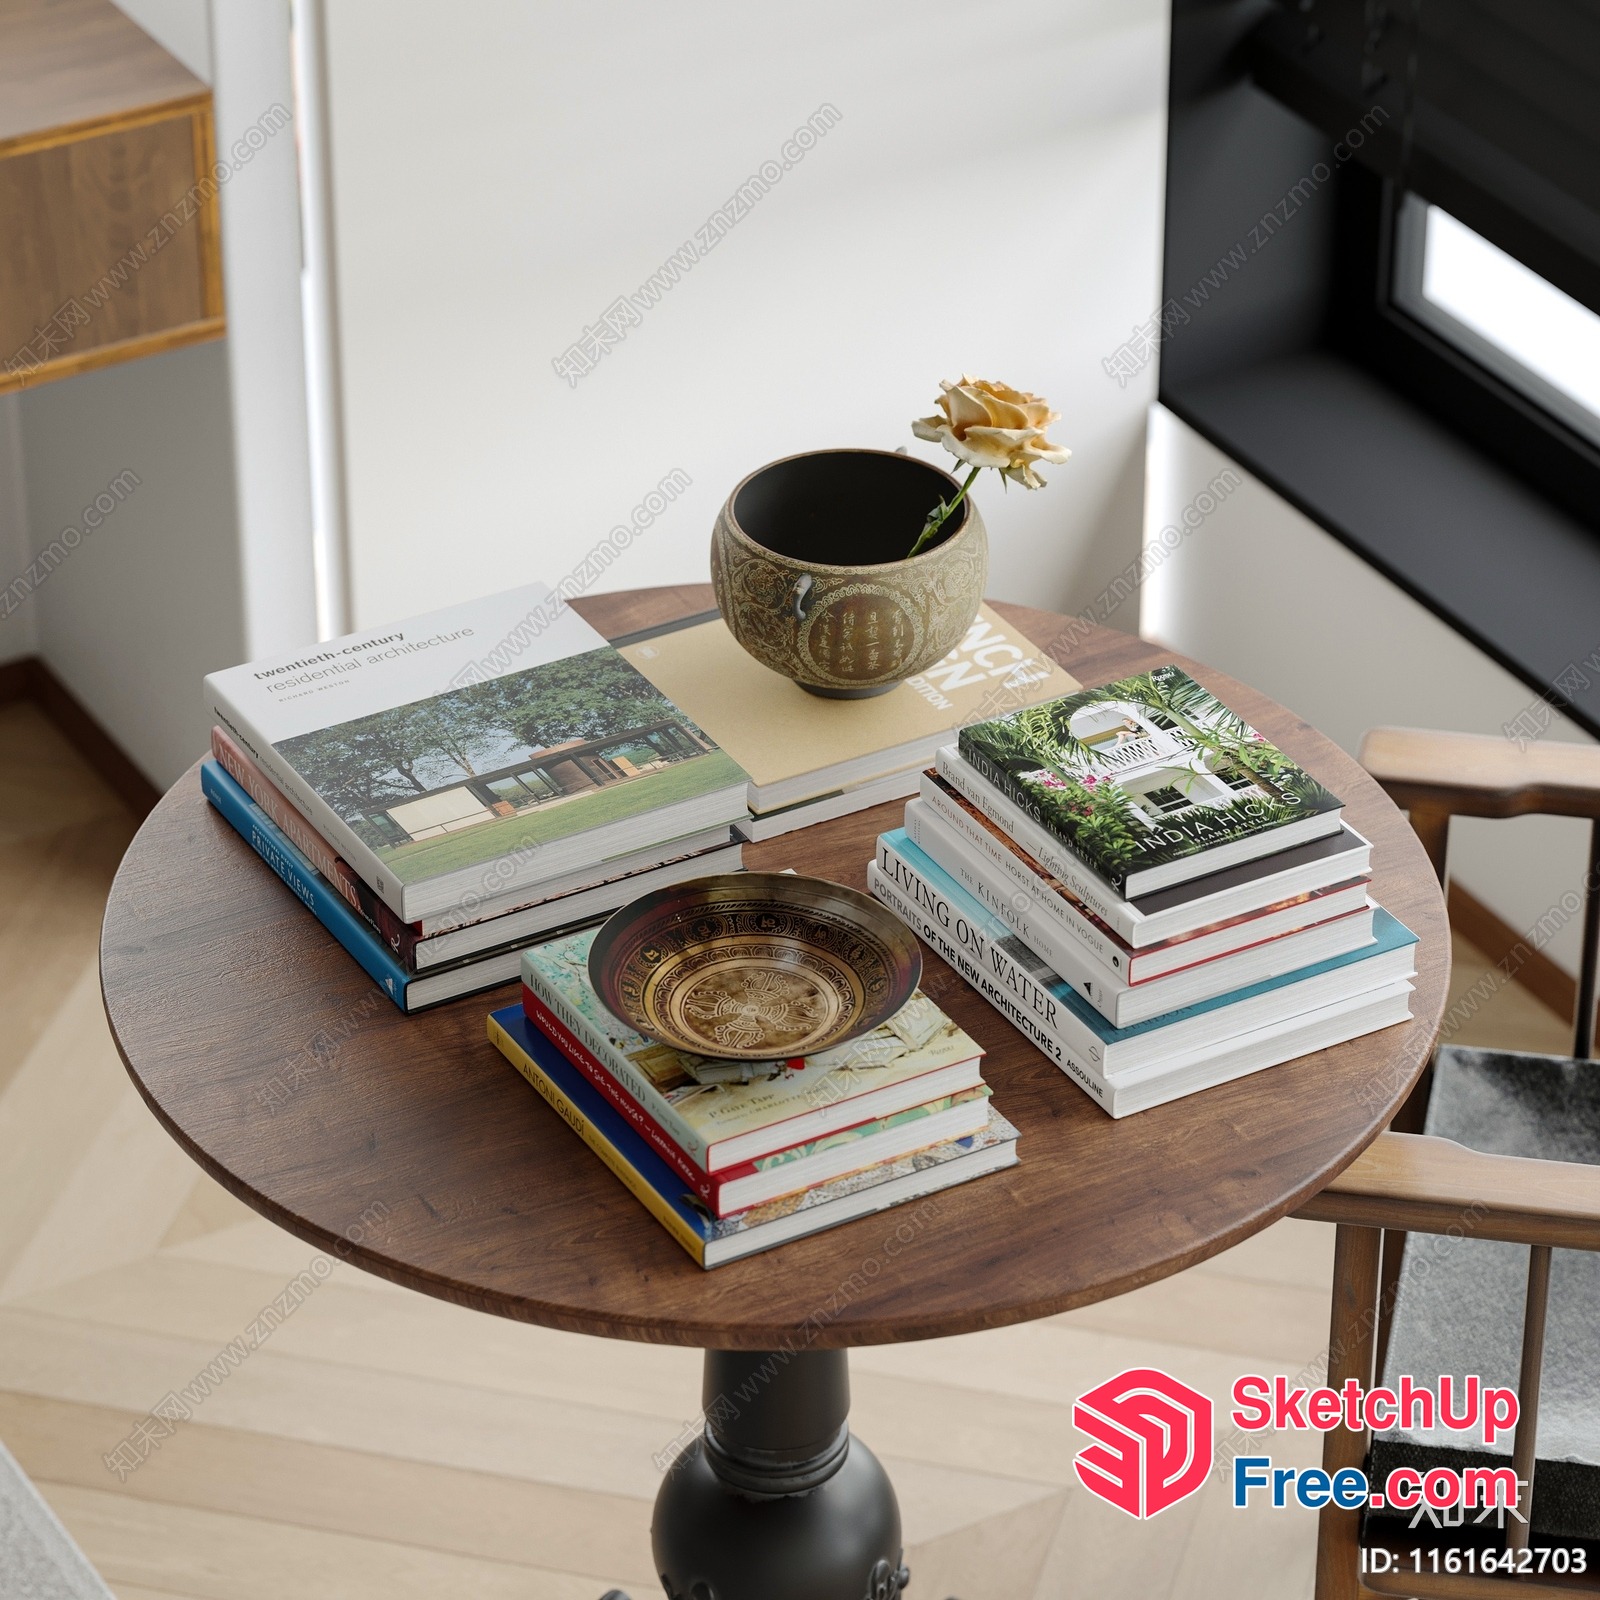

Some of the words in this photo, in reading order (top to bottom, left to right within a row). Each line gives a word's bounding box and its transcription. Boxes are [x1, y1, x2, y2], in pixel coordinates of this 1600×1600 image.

[253, 631, 405, 681] twentieth-century
[266, 658, 362, 694] residential
[366, 627, 475, 665] architecture
[957, 614, 1050, 689] NCH
[278, 689, 314, 702] RICHARD
[317, 679, 351, 692] WESTON
[213, 706, 259, 759] twentieth-century
[942, 761, 965, 790] Brand
[967, 786, 981, 802] van
[982, 796, 1014, 834] Egmond
[968, 749, 1001, 787] INDIA
[1004, 780, 1041, 823] HICKS
[1134, 820, 1214, 852] INDIA
[1214, 792, 1302, 828] HICKS
[218, 743, 245, 785] NEW
[248, 774, 283, 822] YORK
[283, 813, 358, 908] APARTMENTS
[251, 830, 285, 875] PRIVATE
[287, 867, 315, 906] VIEWS
[931, 796, 964, 829] AROUND
[965, 825, 983, 846] THAT
[984, 841, 1002, 863] TIME
[1005, 861, 1030, 888] HORST
[1031, 884, 1040, 896] AT
[1041, 893, 1064, 919] HOME
[1066, 915, 1075, 928] IN
[1076, 927, 1104, 954] VOGUE
[960, 867, 974, 886] THE
[977, 882, 1030, 940] KINFOLK
[1038, 847, 1069, 886] Lighting
[1069, 874, 1108, 917] Sculptures
[881, 847, 950, 928] LIVING
[956, 918, 985, 960] ON
[990, 946, 1059, 1030] WATER
[535, 1009, 556, 1037] WOULD
[873, 877, 922, 930] PORTRAITS
[923, 924, 937, 943] OF
[937, 936, 956, 962] THE
[957, 956, 980, 984] NEW
[980, 978, 1053, 1055] ARCHITECTURE
[1054, 1046, 1062, 1062] 2
[1066, 1058, 1104, 1098] ASSOULINE
[530, 973, 552, 1006] HOW
[554, 997, 583, 1036] THEY
[584, 1030, 646, 1102] DECORATED
[523, 1064, 555, 1105] ANTONI
